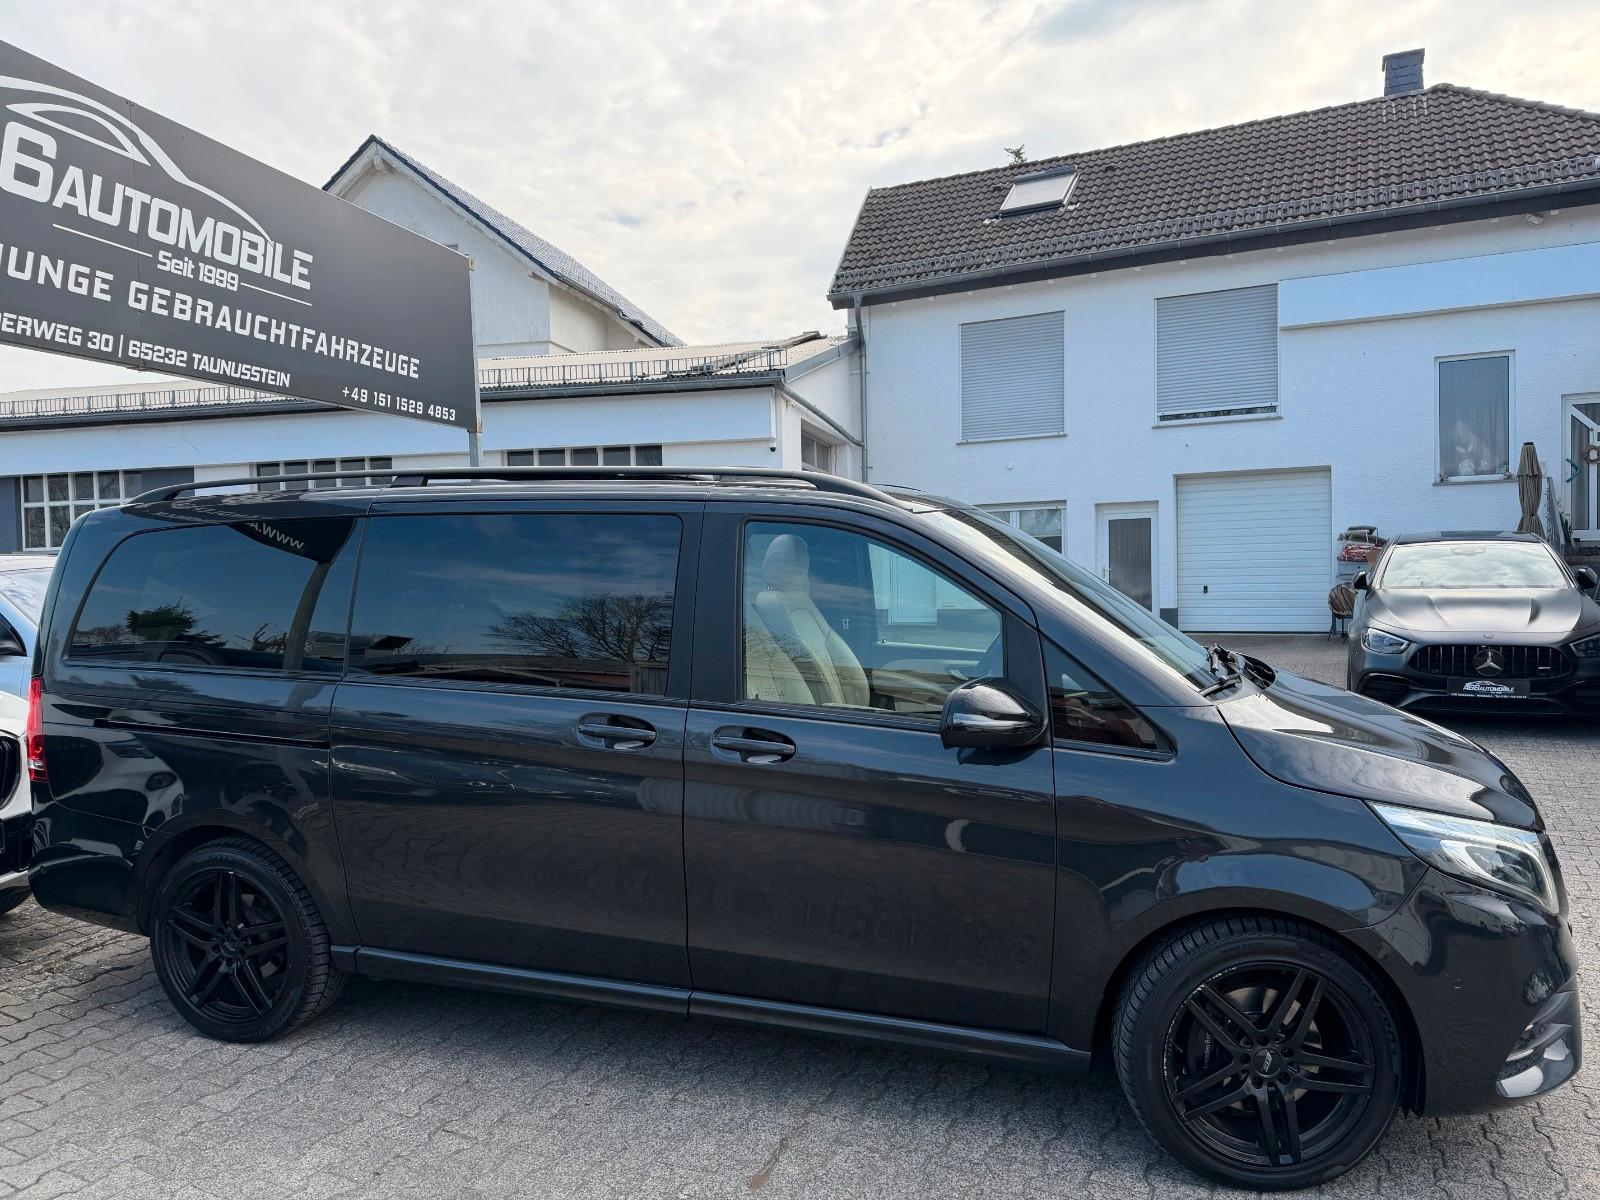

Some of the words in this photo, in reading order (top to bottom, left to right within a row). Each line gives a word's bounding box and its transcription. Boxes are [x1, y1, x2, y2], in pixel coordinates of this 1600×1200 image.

[156, 250, 195, 279] Seit
[198, 262, 239, 292] 1999
[0, 243, 114, 302] UNGE
[127, 280, 421, 379] GEBRAUCHTFAHRZEUGE
[0, 311, 83, 347] ERWEG
[87, 331, 114, 353] 30
[127, 339, 188, 368] 65232
[192, 352, 291, 388] TAUNUSSTEIN
[342, 386, 368, 403] +49
[373, 391, 391, 408] 151
[396, 396, 423, 414] 1529
[428, 404, 456, 421] 4853
